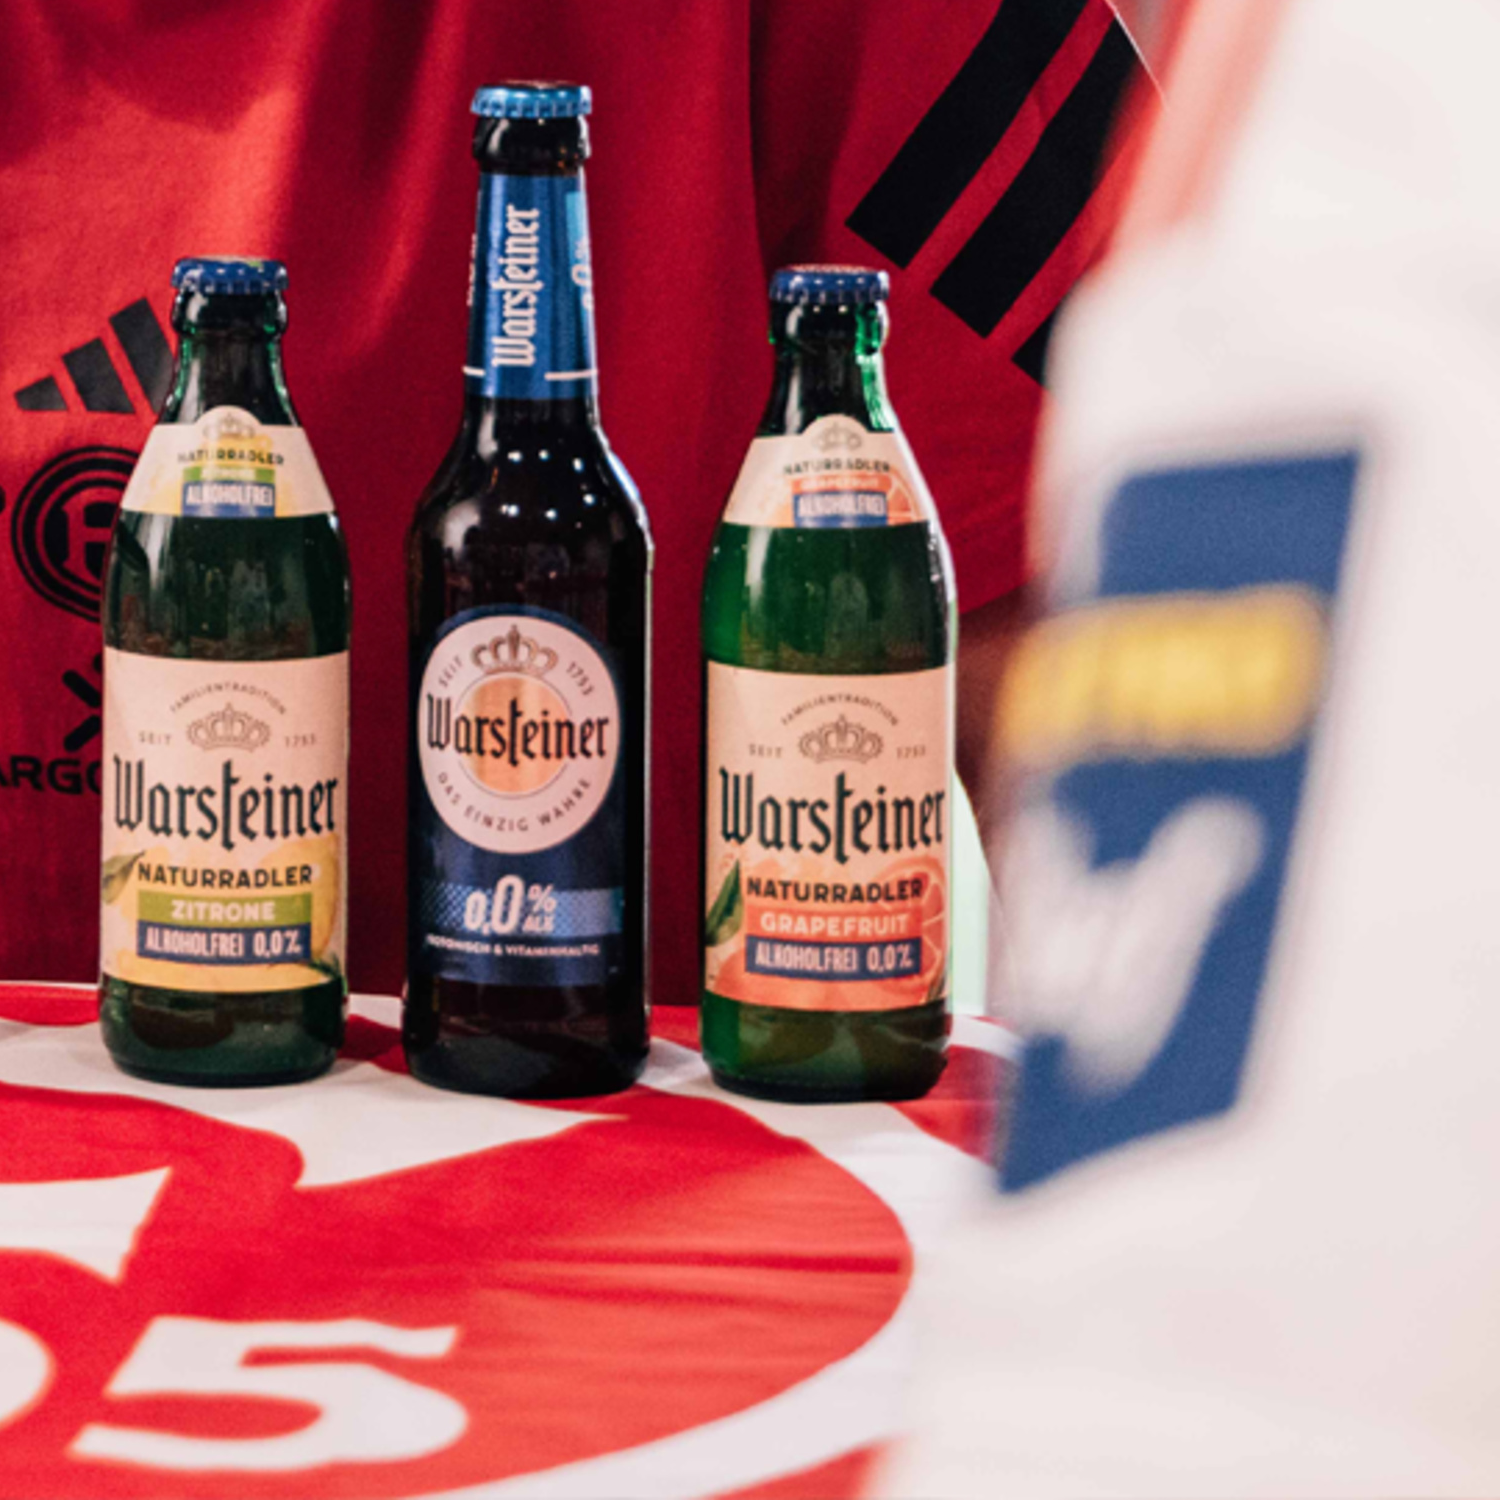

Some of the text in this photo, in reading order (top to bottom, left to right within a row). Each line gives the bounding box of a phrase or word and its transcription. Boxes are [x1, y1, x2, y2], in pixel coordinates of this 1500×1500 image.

[491, 202, 544, 367] Warsteiner
[426, 692, 609, 767] Warsteiner
[113, 754, 338, 851] Warsteiner
[464, 804, 529, 832] EINZIG
[719, 765, 945, 865] Warsteiner
[137, 862, 313, 889] NATURRADLER
[747, 876, 923, 904] NATURRADLER
[171, 899, 276, 922] ZITRONE
[760, 911, 910, 937] GRAPEFRUIT
[145, 926, 245, 957] ALKOHOLFREI
[755, 941, 859, 973] ALKOHOLFREI
